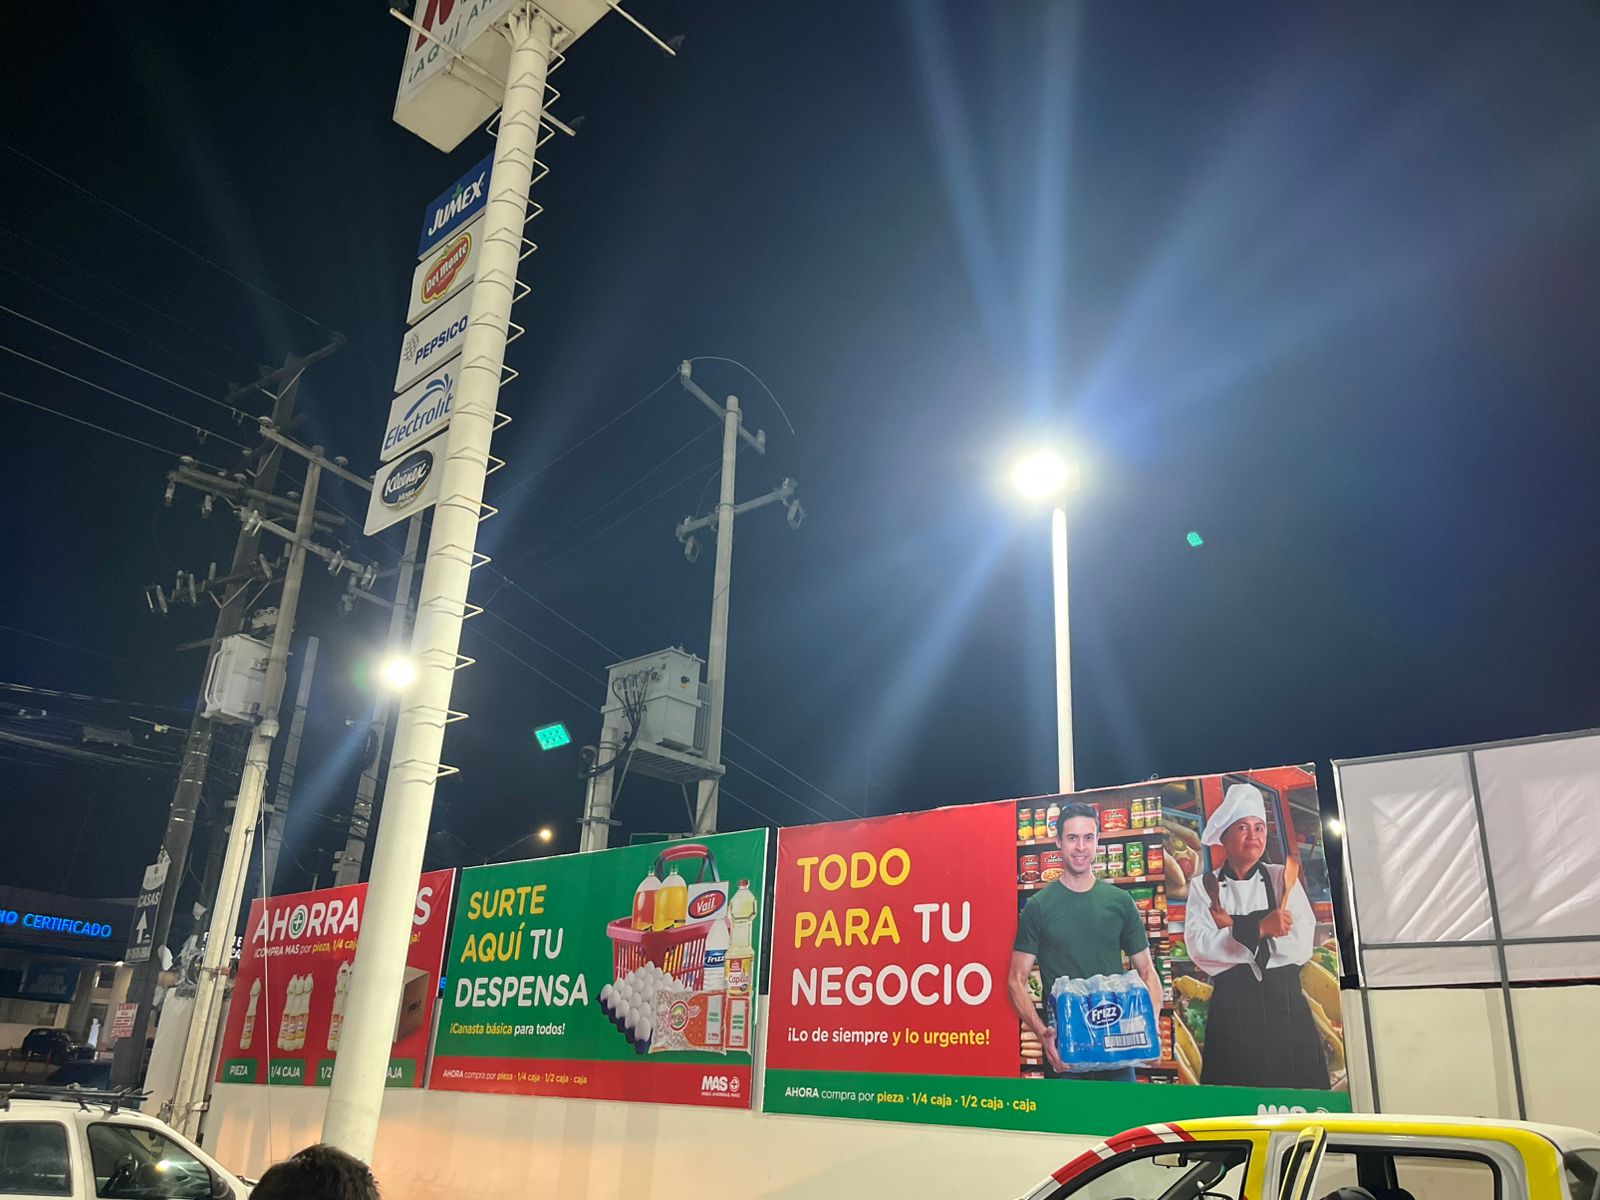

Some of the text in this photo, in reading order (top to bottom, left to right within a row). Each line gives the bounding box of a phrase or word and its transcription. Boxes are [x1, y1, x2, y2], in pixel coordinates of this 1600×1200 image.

[428, 171, 485, 236] JUMEX
[414, 315, 469, 364] PEPSICO
[384, 393, 453, 451] Electrolit
[797, 847, 911, 893] TODO
[252, 897, 359, 943] AHORRA
[413, 887, 433, 926] S
[467, 884, 547, 920] SURTE
[23, 913, 112, 938] CERTIFICADO
[794, 901, 970, 948] PARA TU
[300, 945, 312, 954] por
[333, 938, 343, 951] 1/4
[344, 937, 358, 950] caj
[460, 922, 564, 963] AQUÍ TU
[454, 973, 588, 1008] DESPENSA
[791, 962, 993, 1006] NEGOCIO
[450, 1022, 565, 1037] ¡Canasta básica para todos!
[788, 1027, 990, 1047] ¡Lo de siempre y lo urgente!
[229, 1066, 248, 1076] PIEZA
[271, 1066, 300, 1077] 1/4 CAJA
[321, 1067, 332, 1079] 1/2
[386, 1067, 402, 1079] AJA
[442, 1069, 587, 1085] AHORA compra por pieza 1/4 caja 1/2 caja caja
[701, 1075, 728, 1091] MAS
[785, 1086, 1037, 1112] AHORA compra por pieza 1/4 caja 1/2 caja caja
